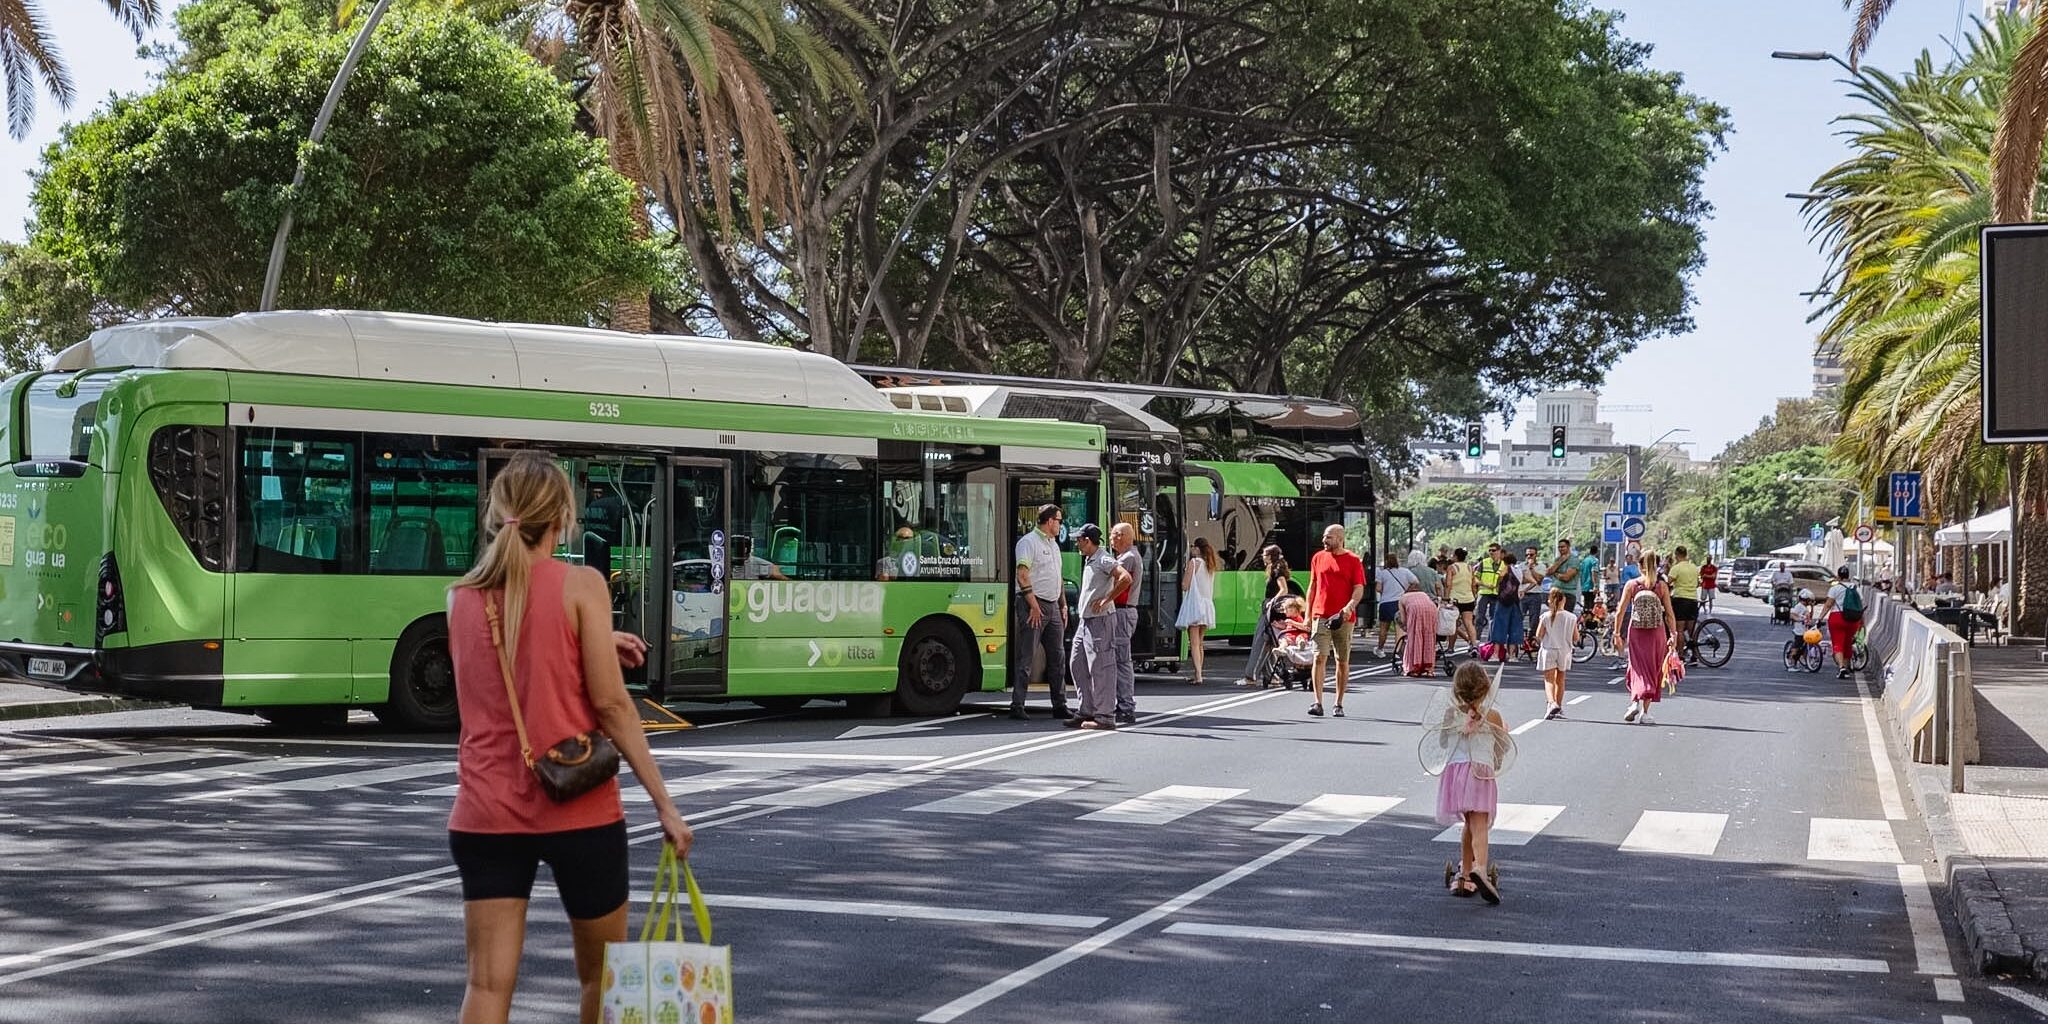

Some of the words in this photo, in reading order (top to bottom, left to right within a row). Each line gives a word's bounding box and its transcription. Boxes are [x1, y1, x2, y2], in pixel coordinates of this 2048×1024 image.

[590, 402, 620, 418] 5235
[27, 523, 67, 550] eco
[920, 555, 937, 565] Santa
[938, 555, 951, 565] Cruz
[952, 555, 960, 565] de
[960, 556, 984, 566] Tenerife
[920, 566, 961, 575] AYUNTAMIENTO
[847, 645, 876, 660] titsa
